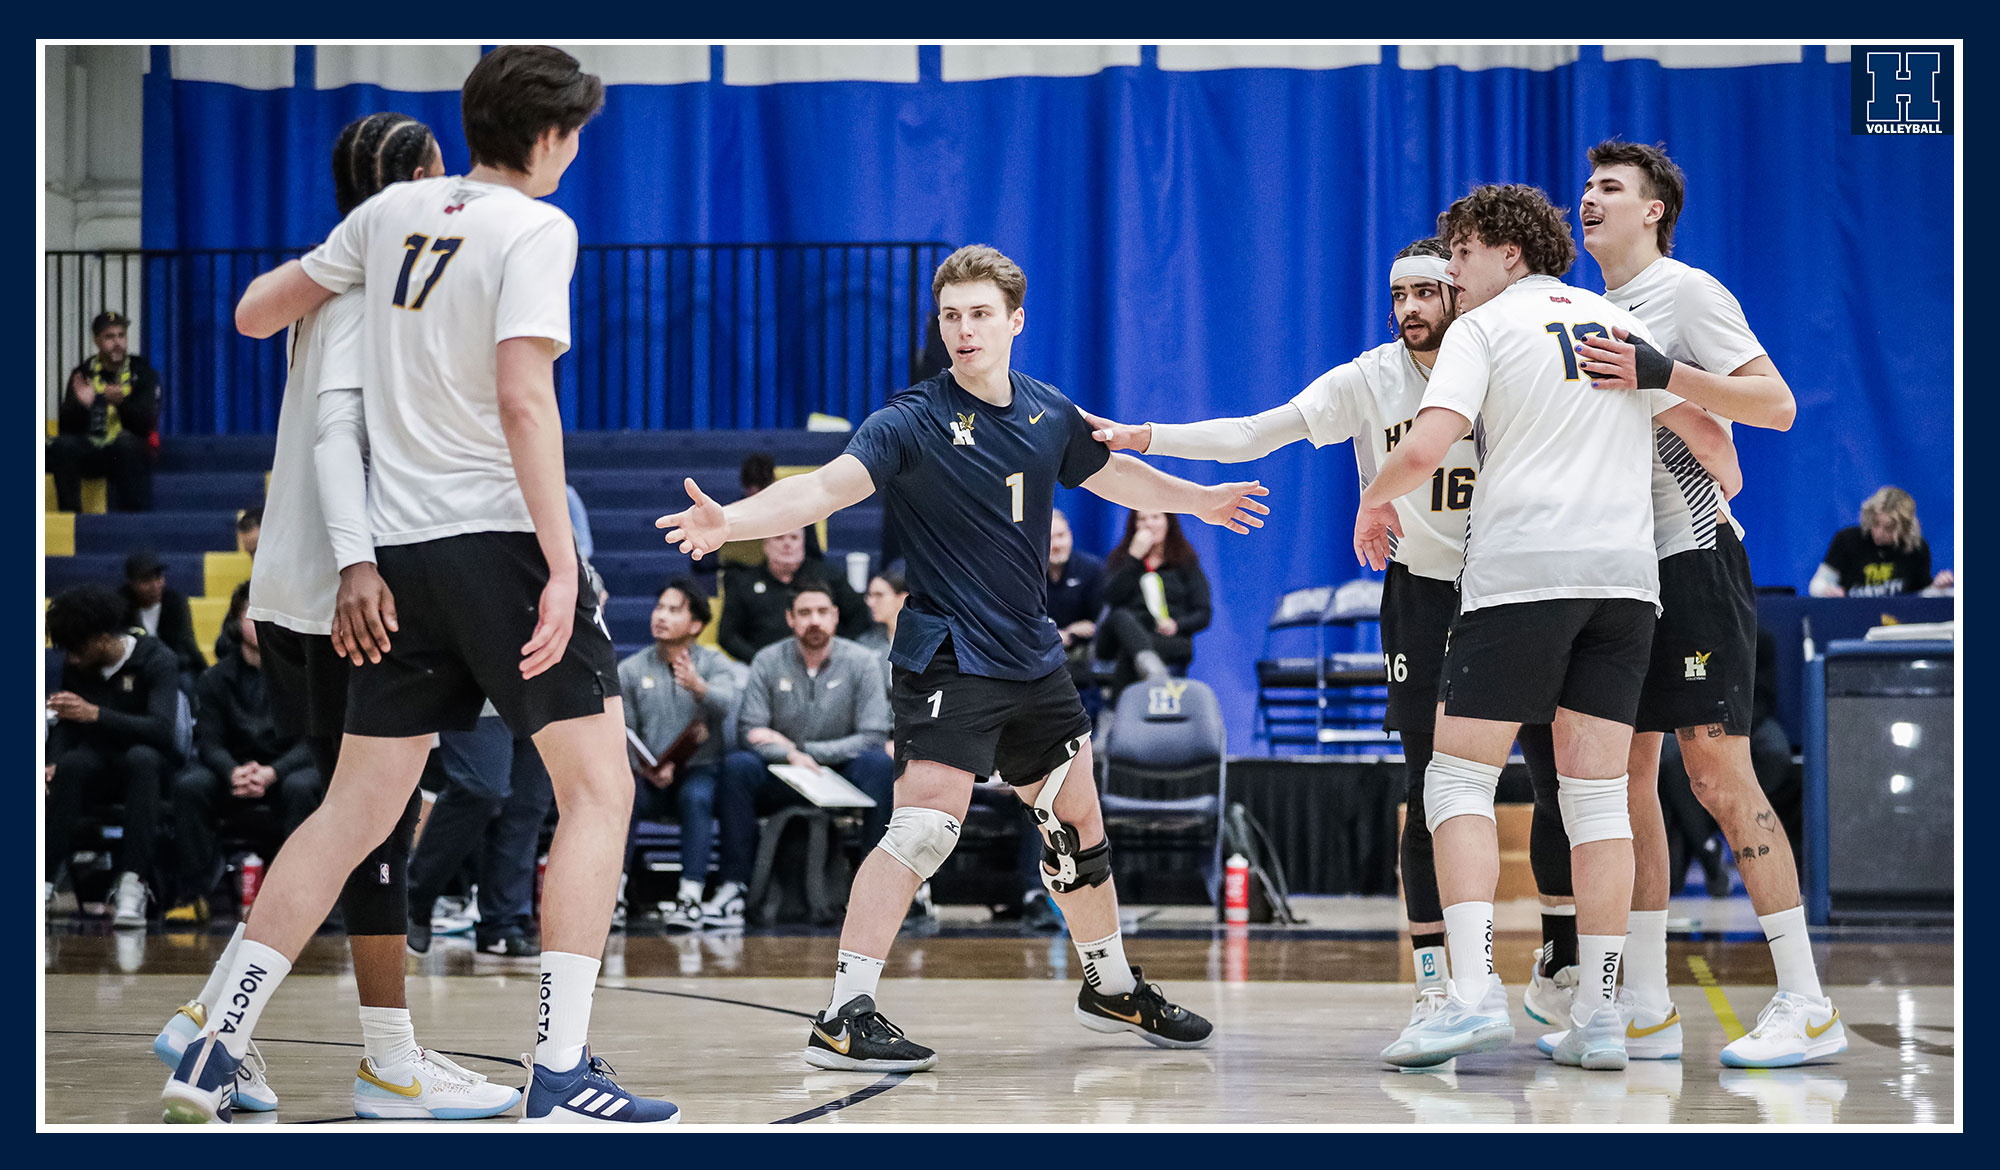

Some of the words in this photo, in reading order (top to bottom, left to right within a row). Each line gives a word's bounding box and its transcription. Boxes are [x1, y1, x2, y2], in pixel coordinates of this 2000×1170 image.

[392, 232, 465, 311] 17
[1005, 471, 1024, 523] 1
[1430, 466, 1477, 512] 16
[1384, 652, 1408, 683] 16
[926, 690, 943, 719] 1
[219, 963, 268, 1034] NOCTA
[536, 972, 552, 1046] NOCTA
